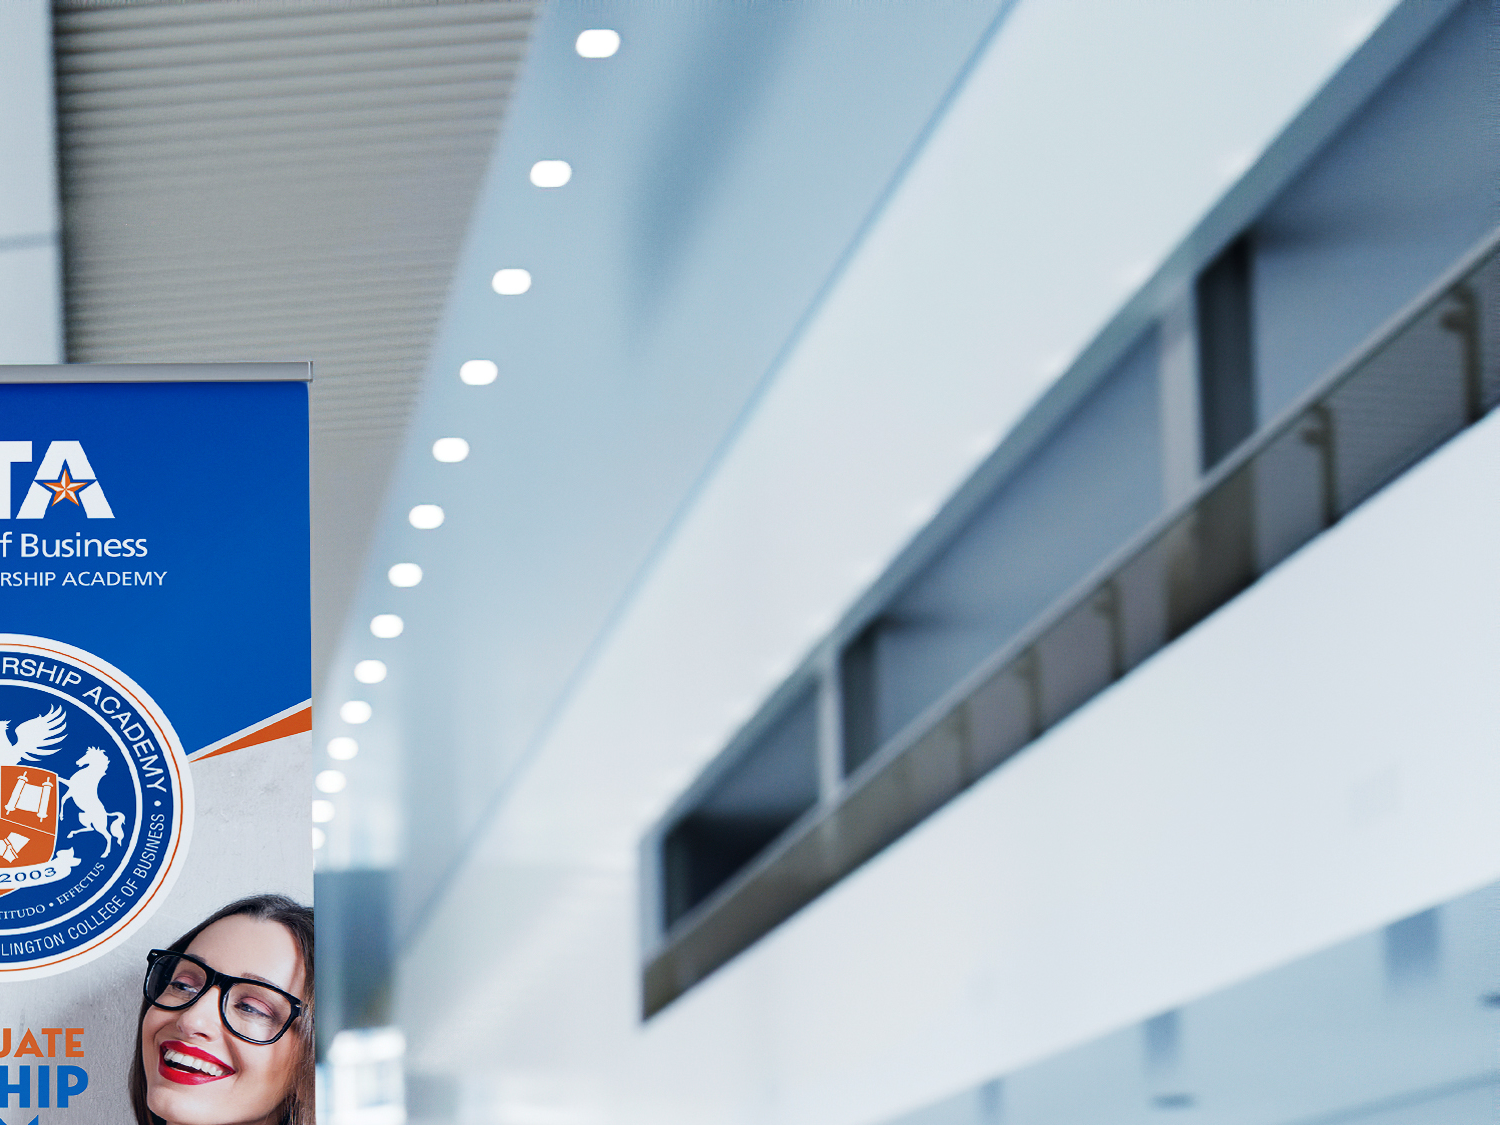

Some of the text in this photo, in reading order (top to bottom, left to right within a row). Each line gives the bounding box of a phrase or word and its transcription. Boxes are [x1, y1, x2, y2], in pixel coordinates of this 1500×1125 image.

[20, 532, 148, 559] Business
[62, 571, 168, 587] ACADEMY
[83, 686, 168, 793] ACADEMY
[0, 866, 57, 884] 2003
[56, 862, 106, 906] EFFECTUS
[67, 895, 126, 941] COLLEGE
[121, 877, 139, 900] OF
[137, 813, 166, 879] BUSINESS
